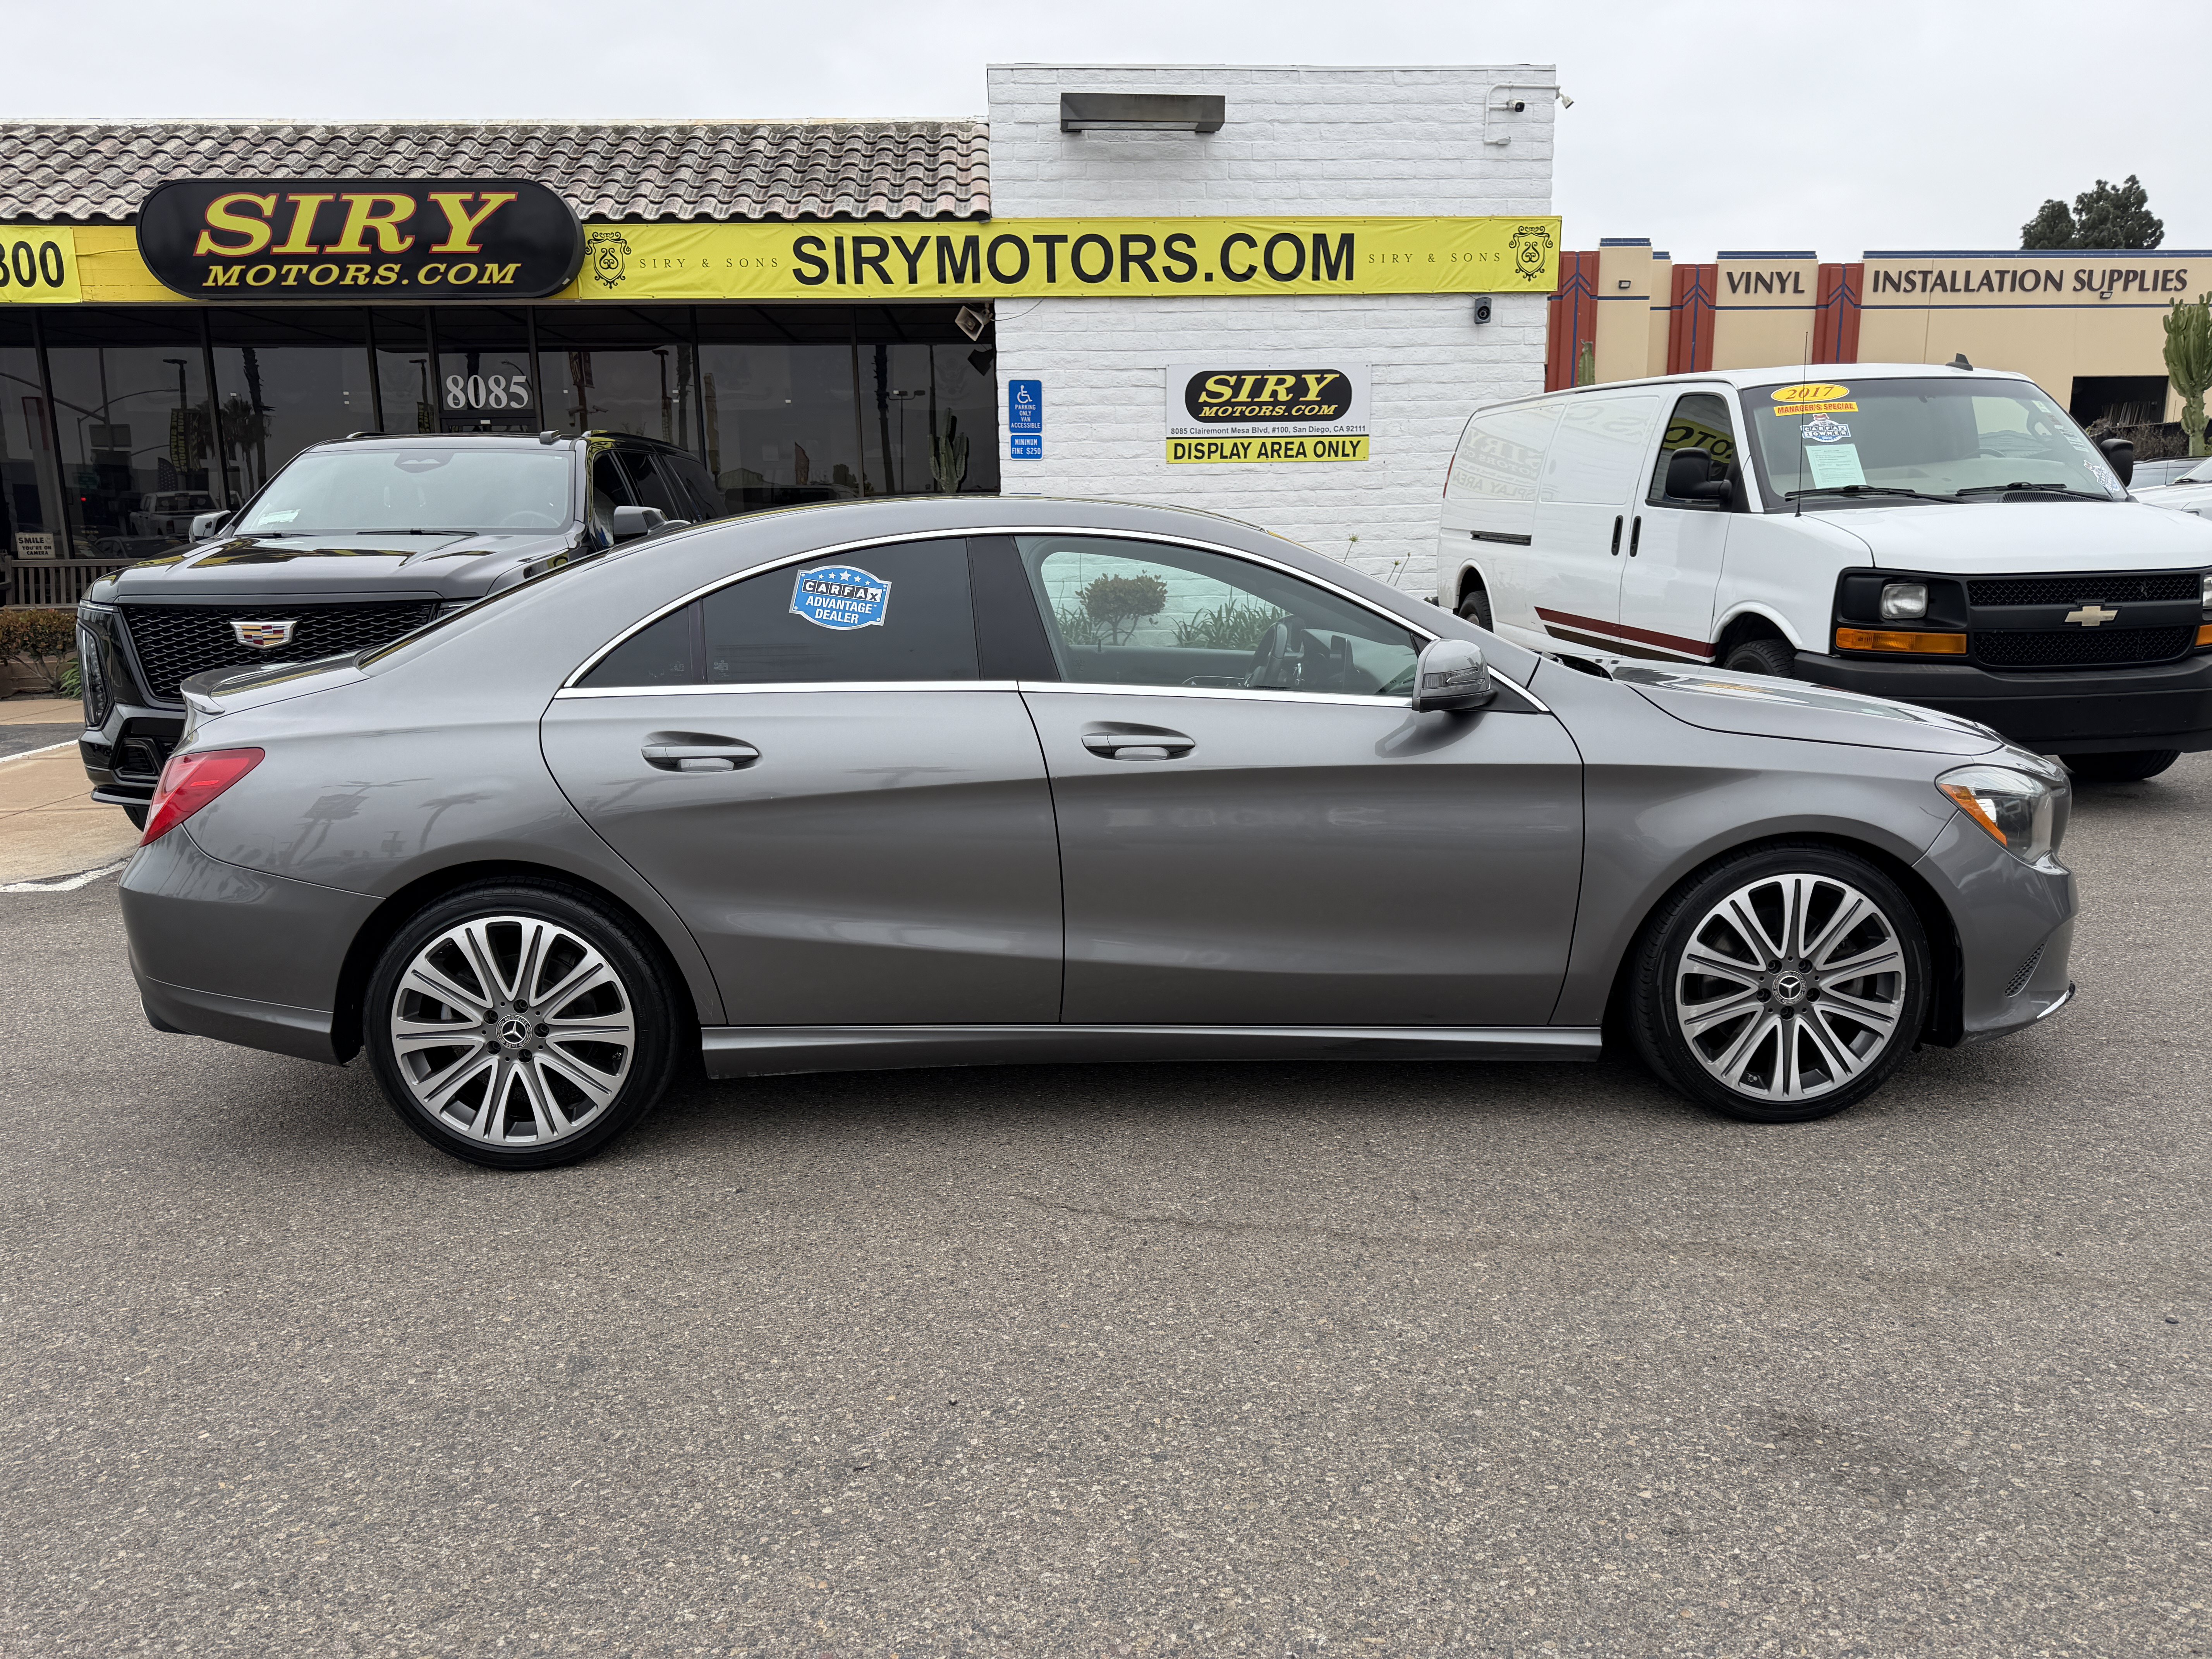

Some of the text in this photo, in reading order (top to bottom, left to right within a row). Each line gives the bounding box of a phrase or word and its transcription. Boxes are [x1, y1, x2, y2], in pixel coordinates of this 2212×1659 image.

[193, 191, 518, 257] SIRY
[640, 258, 778, 268] SIRY & SONS
[792, 233, 1355, 285] SIRYMOTORS.COM
[1369, 252, 1501, 263] SIRY & SONS
[202, 263, 522, 286] MOTORS.COM
[1726, 271, 1805, 294] VINYL
[1872, 269, 2188, 293] INSTALLATION SUPPLIES
[446, 375, 529, 409] 8085
[1198, 374, 1340, 403] SIRY
[1785, 386, 1834, 400] 2017
[1199, 405, 1338, 417] MOTORS.COM
[1778, 404, 1822, 414] MANAGER'S
[1174, 440, 1361, 460] DISPLAY AREA ONLY
[804, 581, 880, 602] CARFAX
[805, 596, 872, 614] ADVANTAGE
[815, 608, 859, 624] DEALER
[504, 1016, 528, 1025] MERCEDES
